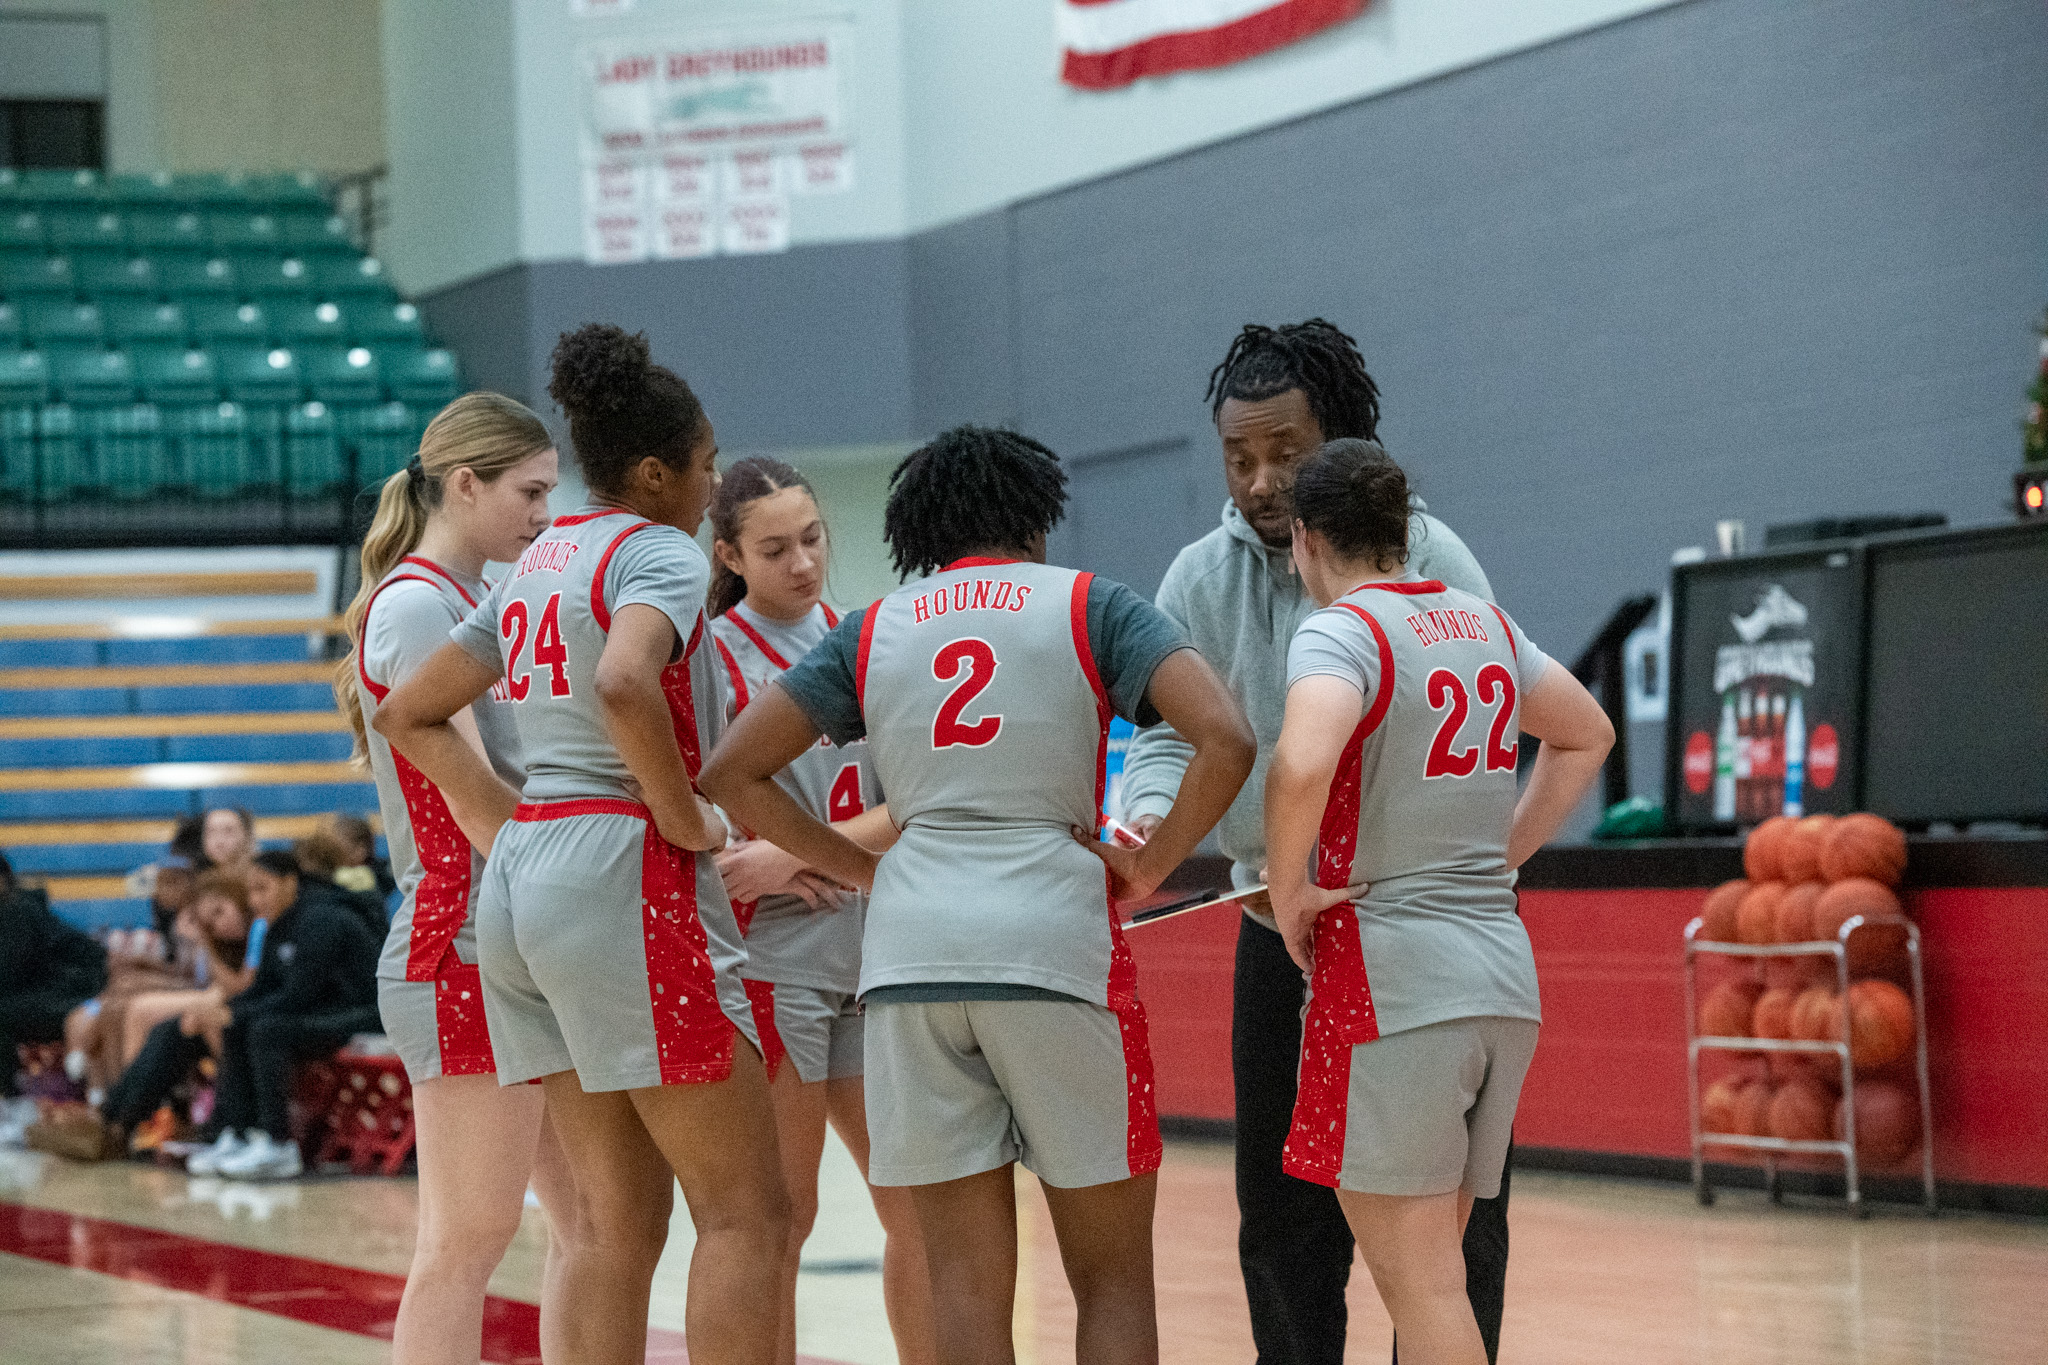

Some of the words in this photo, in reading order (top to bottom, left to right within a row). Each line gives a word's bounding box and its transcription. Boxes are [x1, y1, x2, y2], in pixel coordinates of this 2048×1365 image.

[501, 590, 573, 703] 24
[913, 578, 1034, 625] HOUNDS
[931, 636, 1003, 751] 2
[1422, 661, 1519, 780] 22
[826, 762, 867, 825] 4
